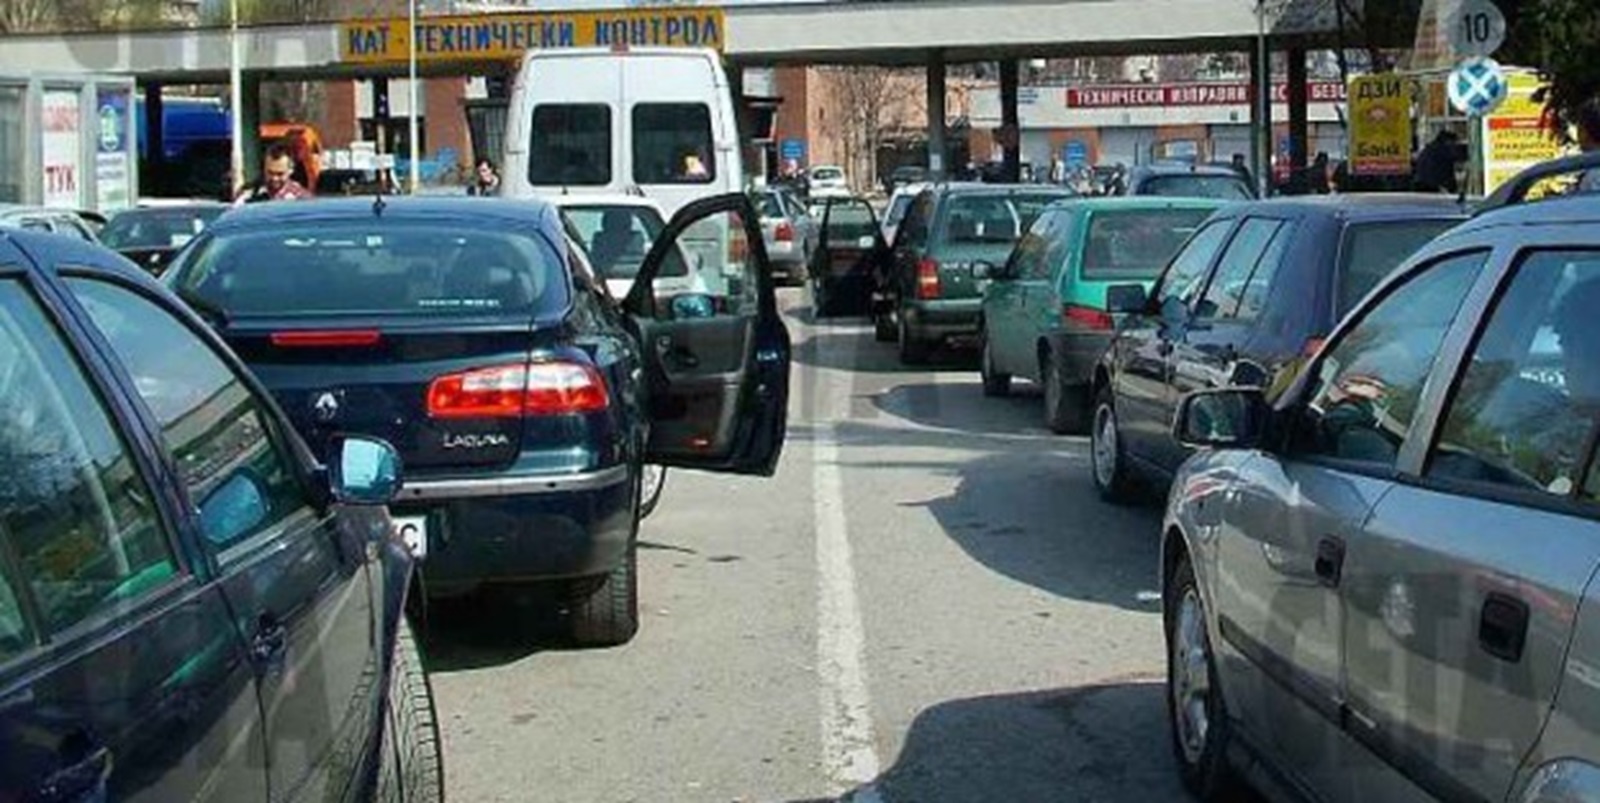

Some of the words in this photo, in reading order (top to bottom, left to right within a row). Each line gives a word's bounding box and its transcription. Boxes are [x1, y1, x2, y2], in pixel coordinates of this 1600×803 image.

[348, 25, 390, 55] КАТ
[414, 20, 574, 53] ТЕХНИЧЕСКИ
[595, 14, 719, 47] КОНТРОЛ
[1463, 12, 1489, 43] 10
[1076, 84, 1164, 107] ТЕХНИЧЕСКИ
[1356, 80, 1401, 101] ДЗИ
[45, 164, 76, 194] ТУК
[442, 432, 509, 448] LAGUNA
